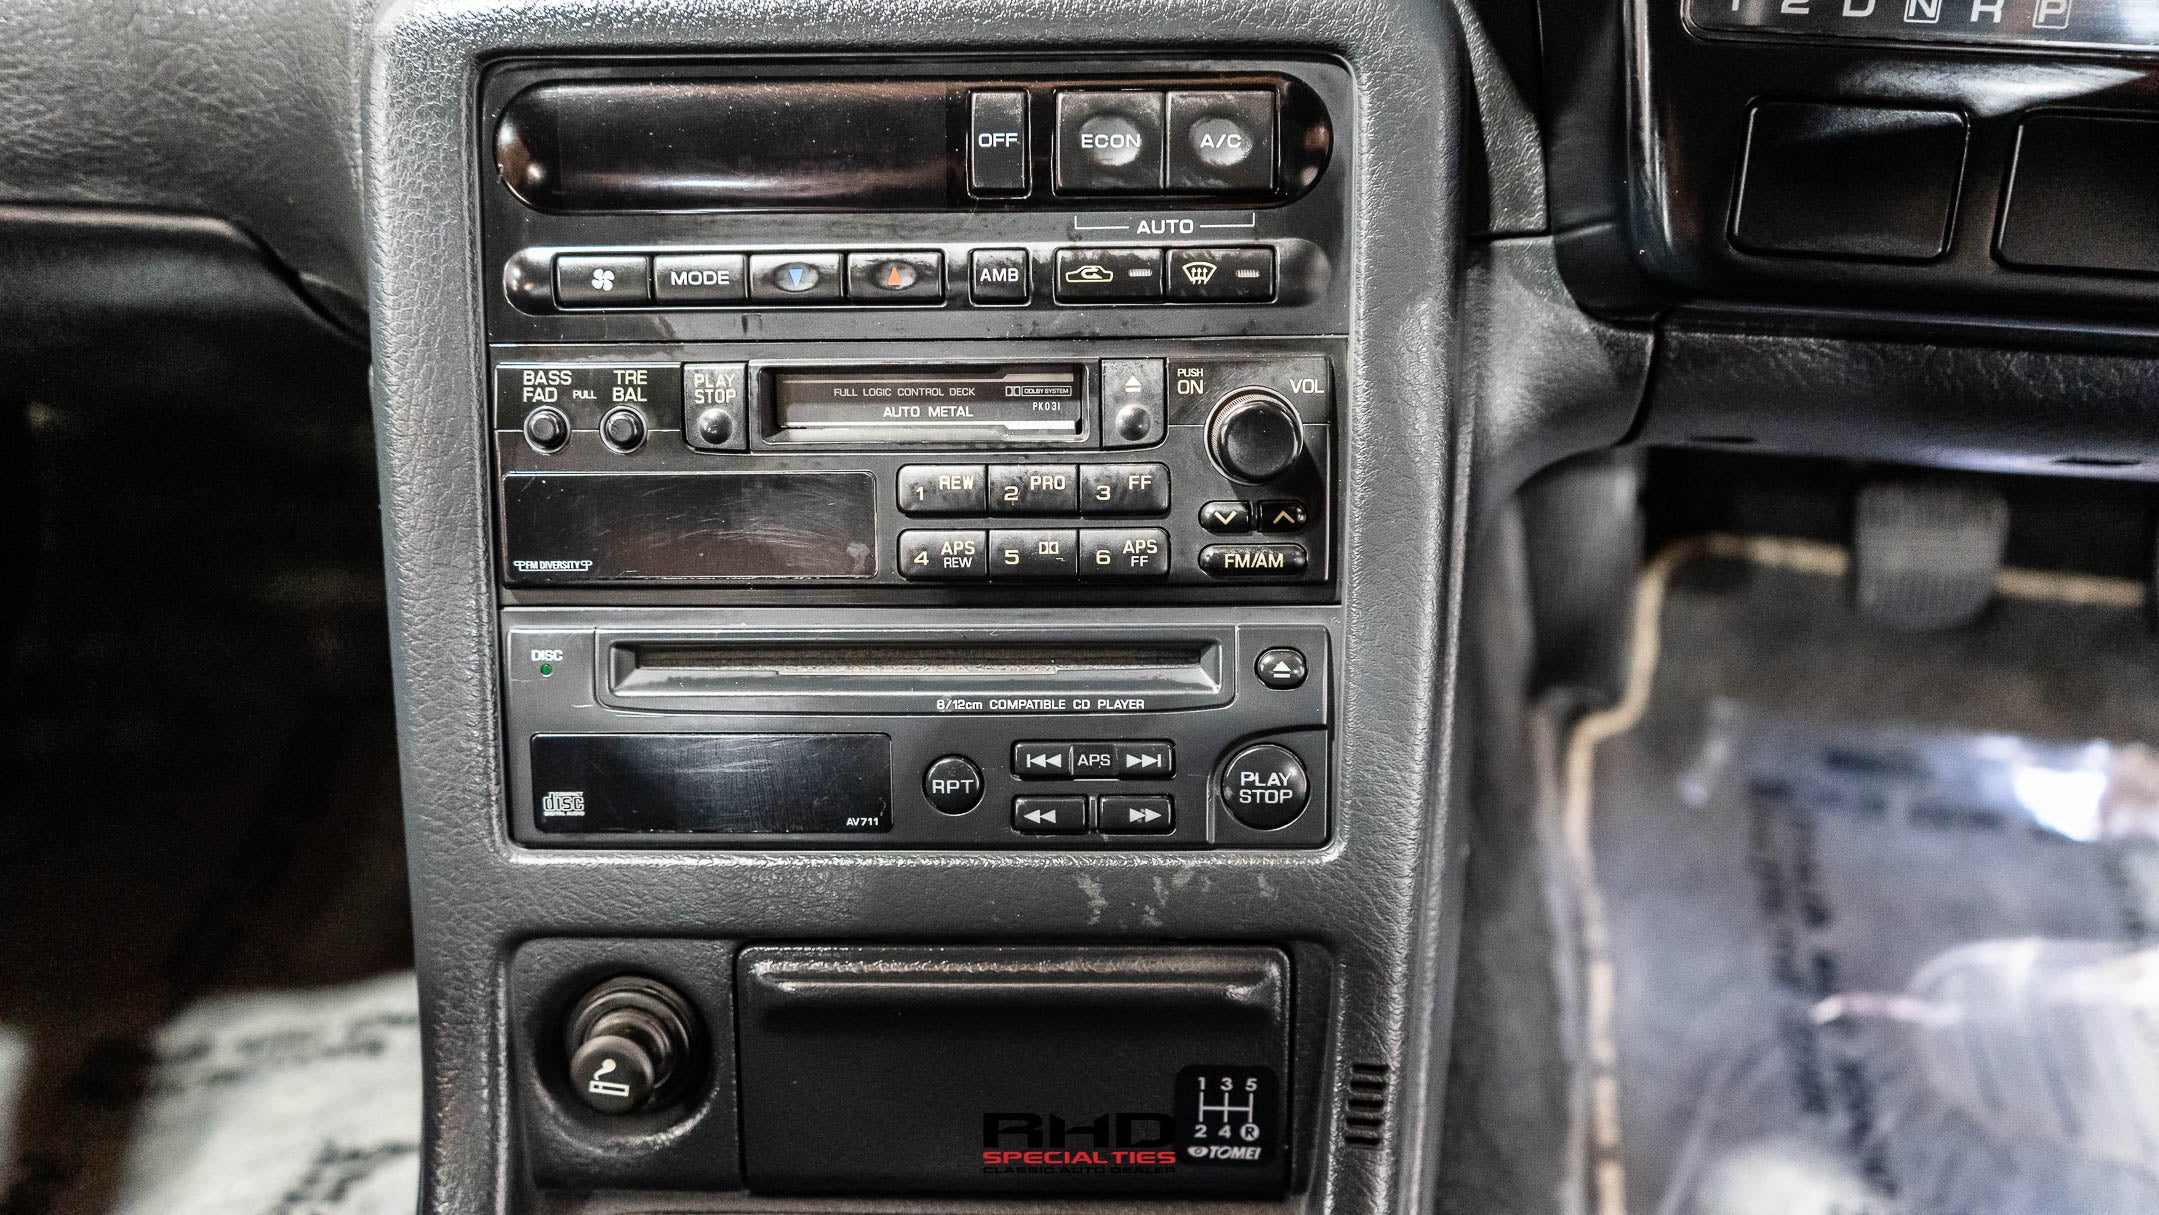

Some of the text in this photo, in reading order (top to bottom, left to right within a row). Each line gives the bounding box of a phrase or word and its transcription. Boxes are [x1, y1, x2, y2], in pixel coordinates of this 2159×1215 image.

[1908, 0, 1938, 18] N
[1970, 0, 2003, 23] R
[2037, 0, 2067, 24] P
[978, 132, 1019, 148] OFF
[1080, 133, 1142, 149] ECON
[1199, 133, 1242, 149] A/C
[1136, 219, 1194, 235] AUTO
[670, 270, 730, 286] MODE
[979, 267, 1019, 283] AMB
[522, 370, 573, 386] BASS
[612, 370, 648, 385] TRE
[1177, 368, 1204, 377] PUSH
[693, 373, 735, 388] PLAY
[1177, 379, 1204, 395] ON
[1289, 379, 1325, 394] VOL
[522, 387, 558, 402] FAD
[572, 389, 597, 400] PULL
[612, 387, 648, 402] BAL
[694, 389, 737, 404] STOP
[833, 387, 976, 397] FULL LOGIC CONTROL DECK
[883, 405, 974, 418] AUTO METAL
[915, 475, 975, 501] 1 REW
[1003, 475, 1066, 501] 2 PRO
[1096, 475, 1152, 500] 3 FF
[913, 540, 975, 566] 4 APS
[1004, 550, 1020, 565] 5
[1096, 540, 1158, 565] 6 APS
[943, 557, 973, 568] REW
[1130, 556, 1149, 567] FF
[1224, 553, 1284, 568] FM/AM
[531, 649, 564, 662] DISC
[936, 699, 1145, 711] 8/12cm COMPATIBLE CD PLAYER
[1076, 753, 1112, 768] APS
[1240, 771, 1292, 787] PLAY
[931, 779, 976, 795] RPT
[1239, 788, 1293, 804] STOP
[846, 817, 880, 827] AV711
[1197, 1076, 1258, 1092] 1 3 5
[1194, 1124, 1208, 1138] 2
[1218, 1124, 1232, 1139] 4
[1208, 1146, 1262, 1161] TOMEI
